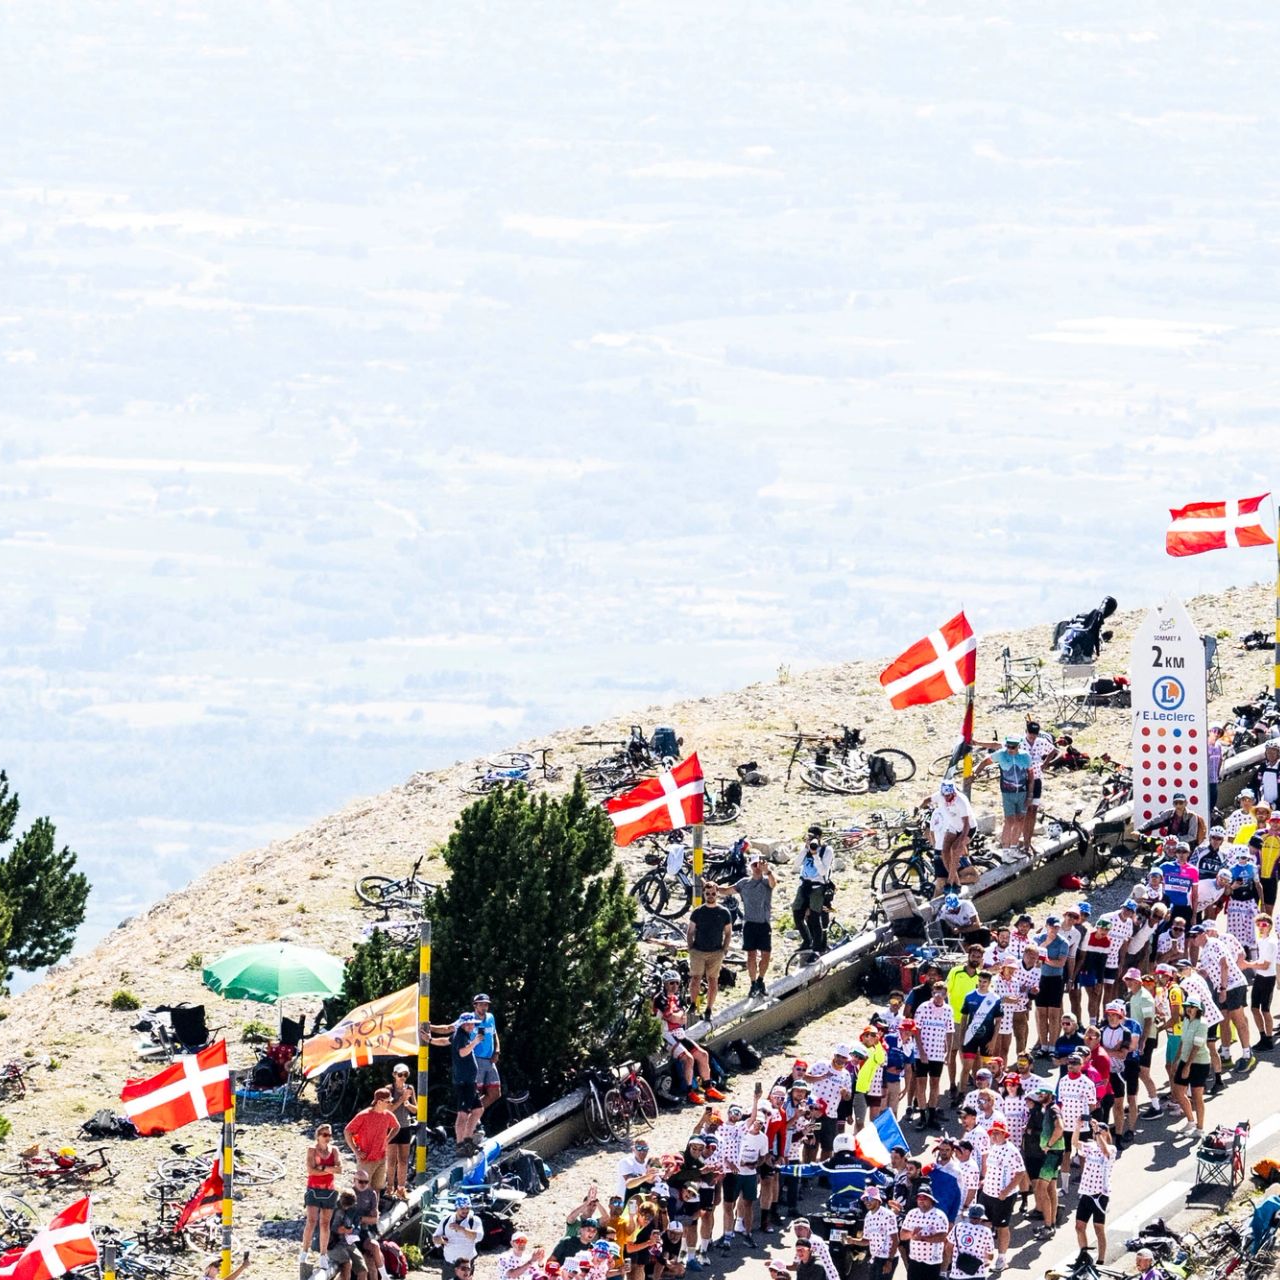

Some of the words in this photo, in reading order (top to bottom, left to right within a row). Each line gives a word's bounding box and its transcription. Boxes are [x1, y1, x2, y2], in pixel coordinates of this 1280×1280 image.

[1152, 645, 1163, 667] 2
[1165, 656, 1185, 668] KM
[1143, 710, 1196, 722] E.Leclerc
